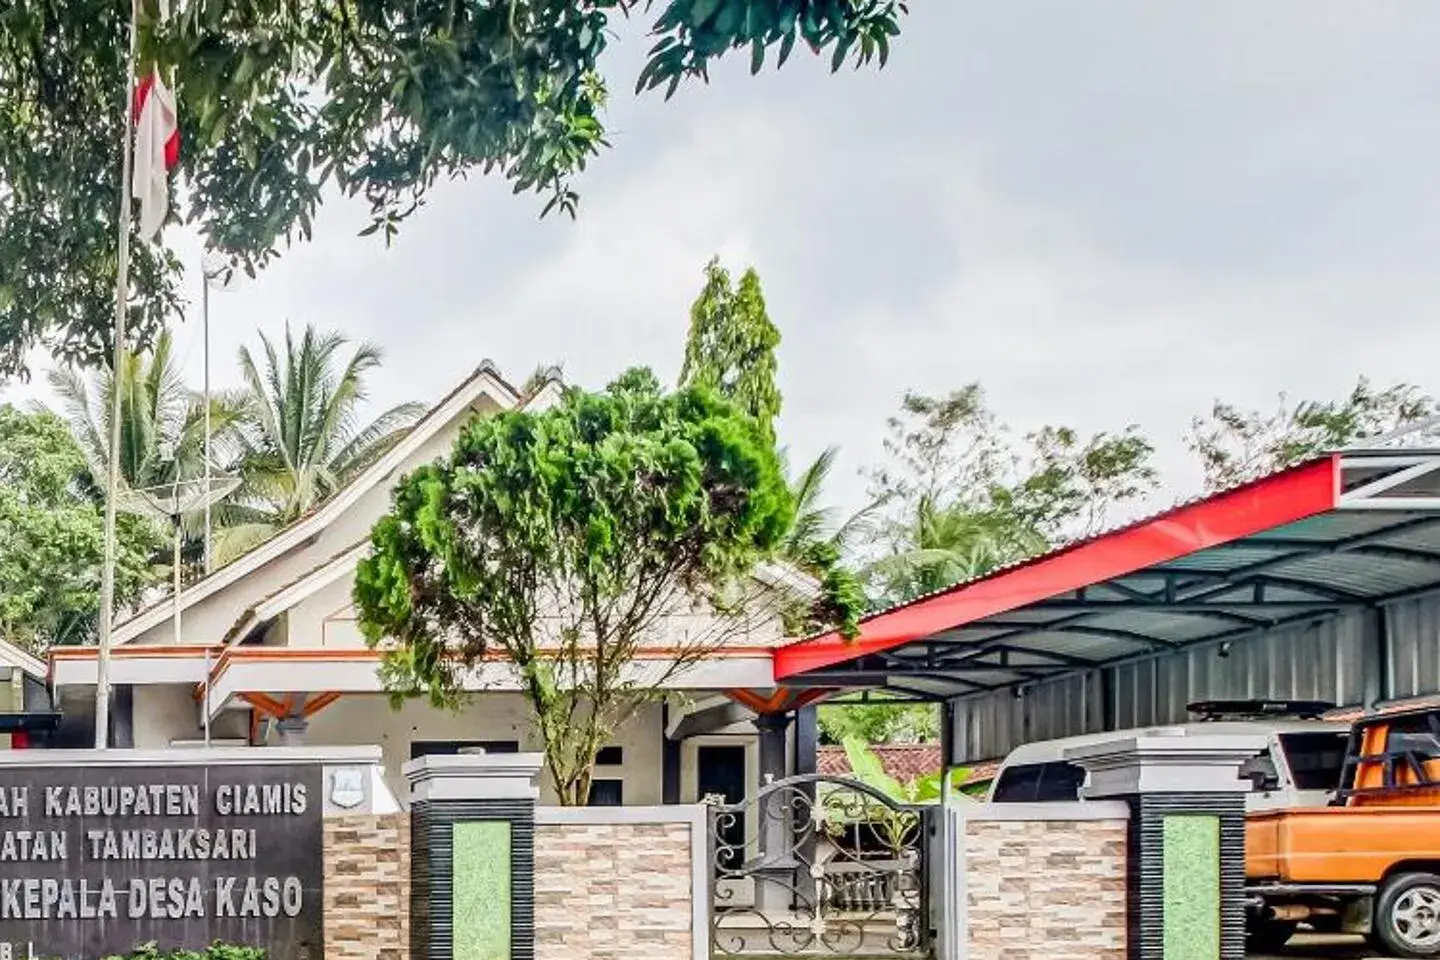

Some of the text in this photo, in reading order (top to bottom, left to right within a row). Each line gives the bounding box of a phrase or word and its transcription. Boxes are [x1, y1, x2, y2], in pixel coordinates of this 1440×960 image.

[44, 784, 200, 817] KABUPATEN
[216, 782, 307, 816] CIAMIS
[87, 828, 257, 860] TAMBAKSARI
[0, 878, 118, 920] KEPALA
[127, 876, 205, 919] DESA
[216, 876, 303, 918] KASO
